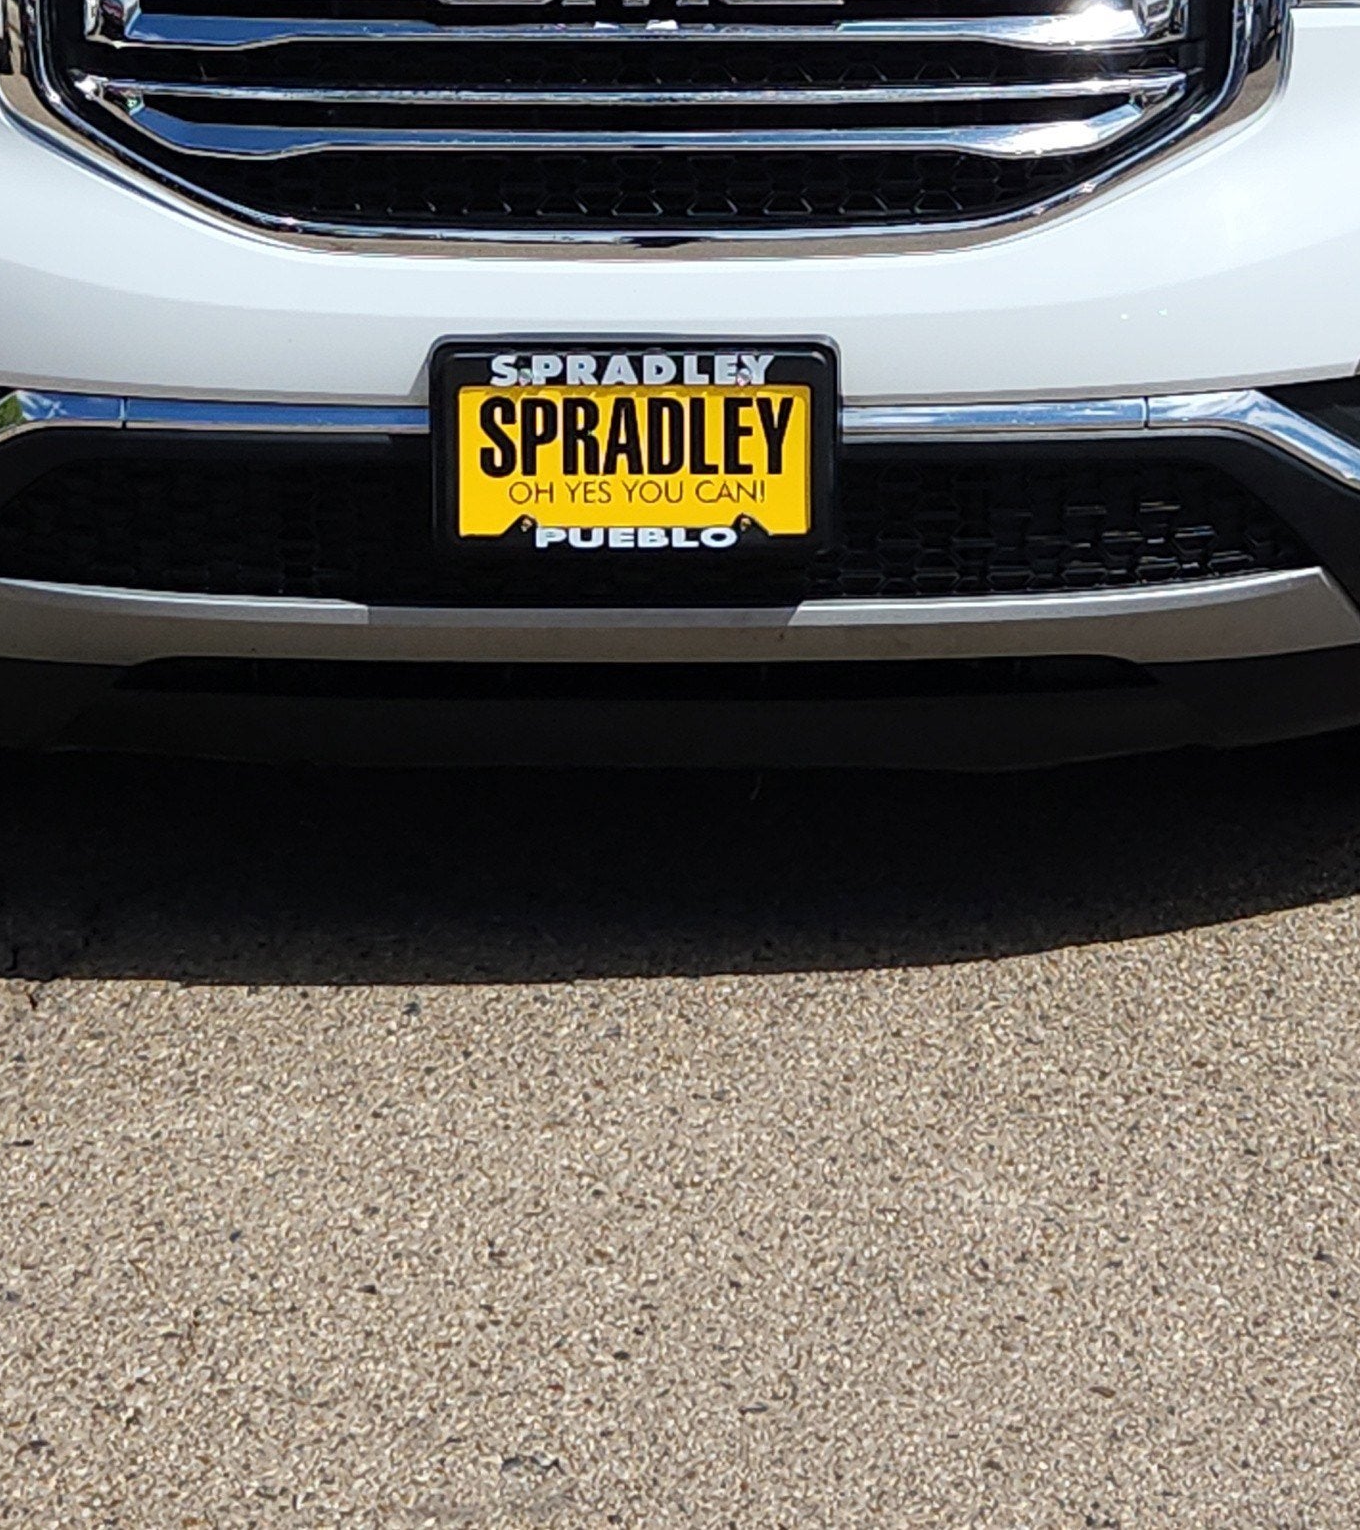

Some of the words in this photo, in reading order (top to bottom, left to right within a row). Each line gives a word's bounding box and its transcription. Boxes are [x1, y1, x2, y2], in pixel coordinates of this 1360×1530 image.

[490, 353, 775, 387] SPRADLEY
[478, 395, 795, 478] SPRADLEY
[508, 481, 555, 504] OH
[564, 480, 612, 504] YES
[621, 480, 685, 504] YOU
[694, 479, 767, 505] CAN!
[535, 526, 738, 549] PUEBLO
